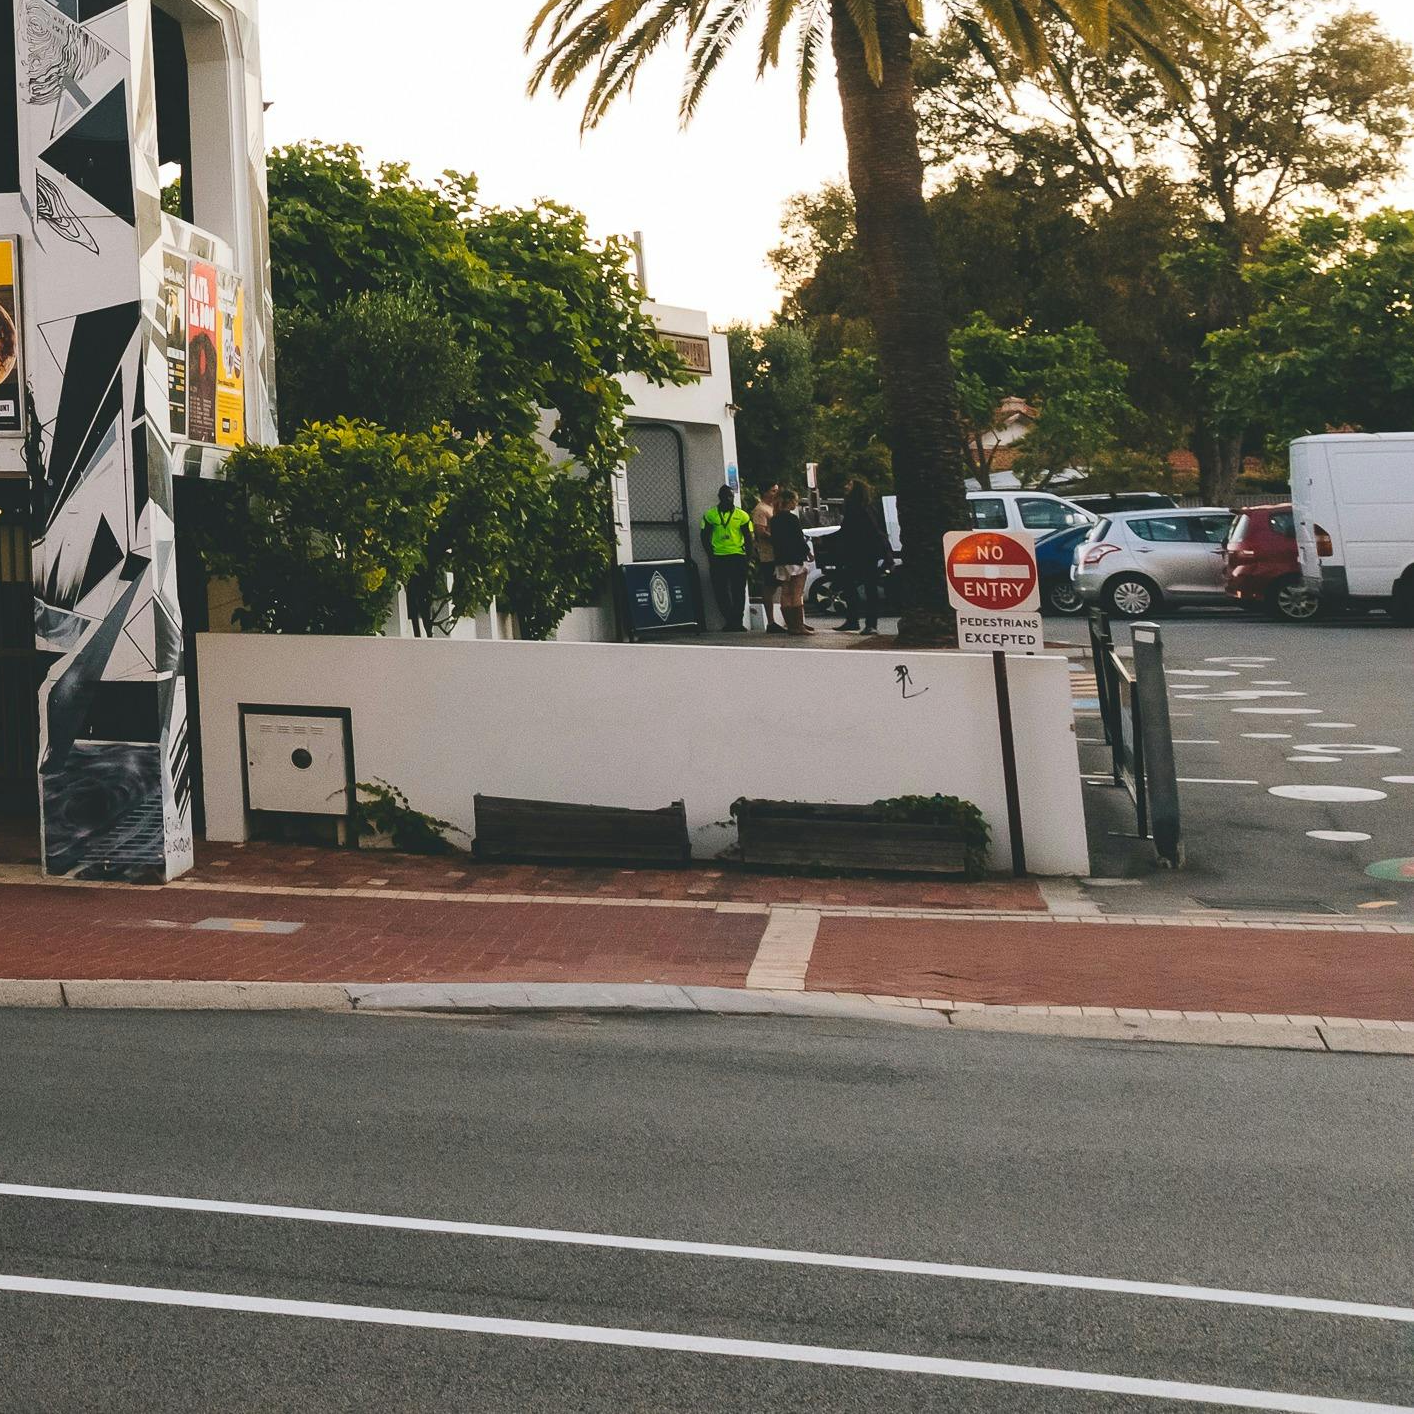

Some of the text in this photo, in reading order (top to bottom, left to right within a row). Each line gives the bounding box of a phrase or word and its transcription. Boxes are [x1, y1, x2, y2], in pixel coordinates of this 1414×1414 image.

[976, 545, 1004, 561] NO
[963, 581, 1024, 597] ENTRY
[959, 617, 1039, 629] PEDESTRIANS
[965, 632, 1036, 646] EXCEPTED
